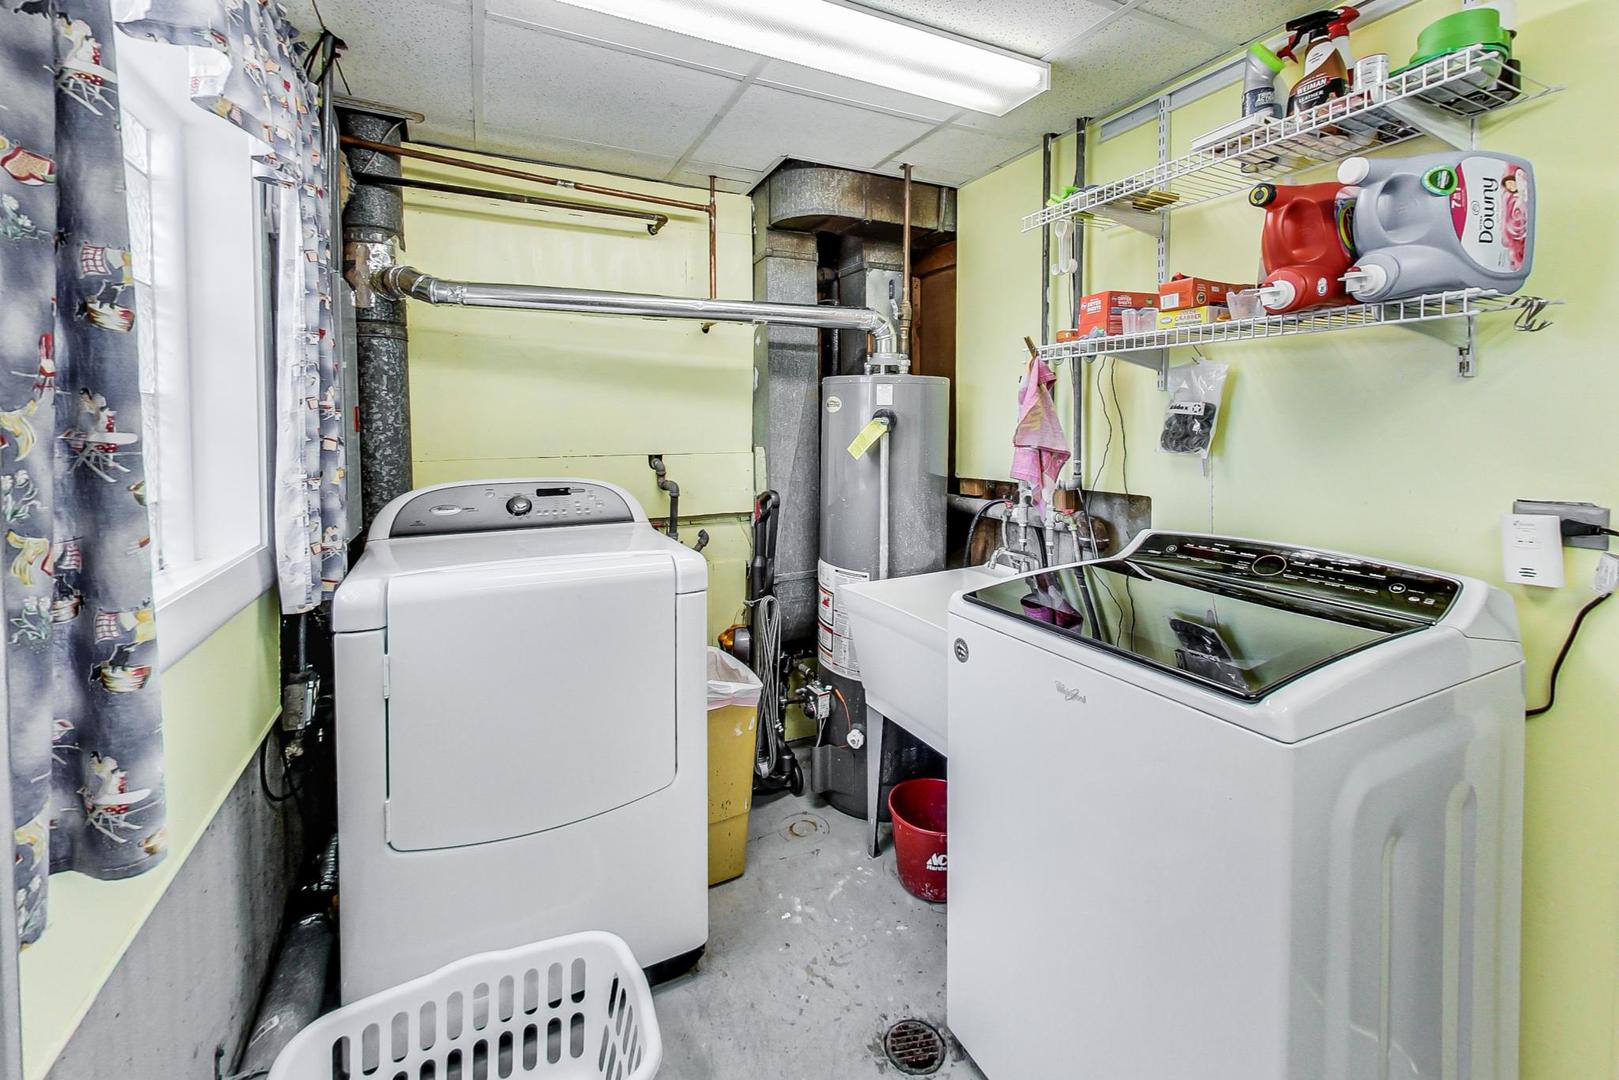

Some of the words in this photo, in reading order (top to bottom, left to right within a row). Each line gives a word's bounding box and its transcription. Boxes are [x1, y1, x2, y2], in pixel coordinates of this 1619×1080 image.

[1296, 78, 1328, 95] WEIMAN
[1478, 177, 1499, 244] Downy
[926, 852, 947, 866] AC
